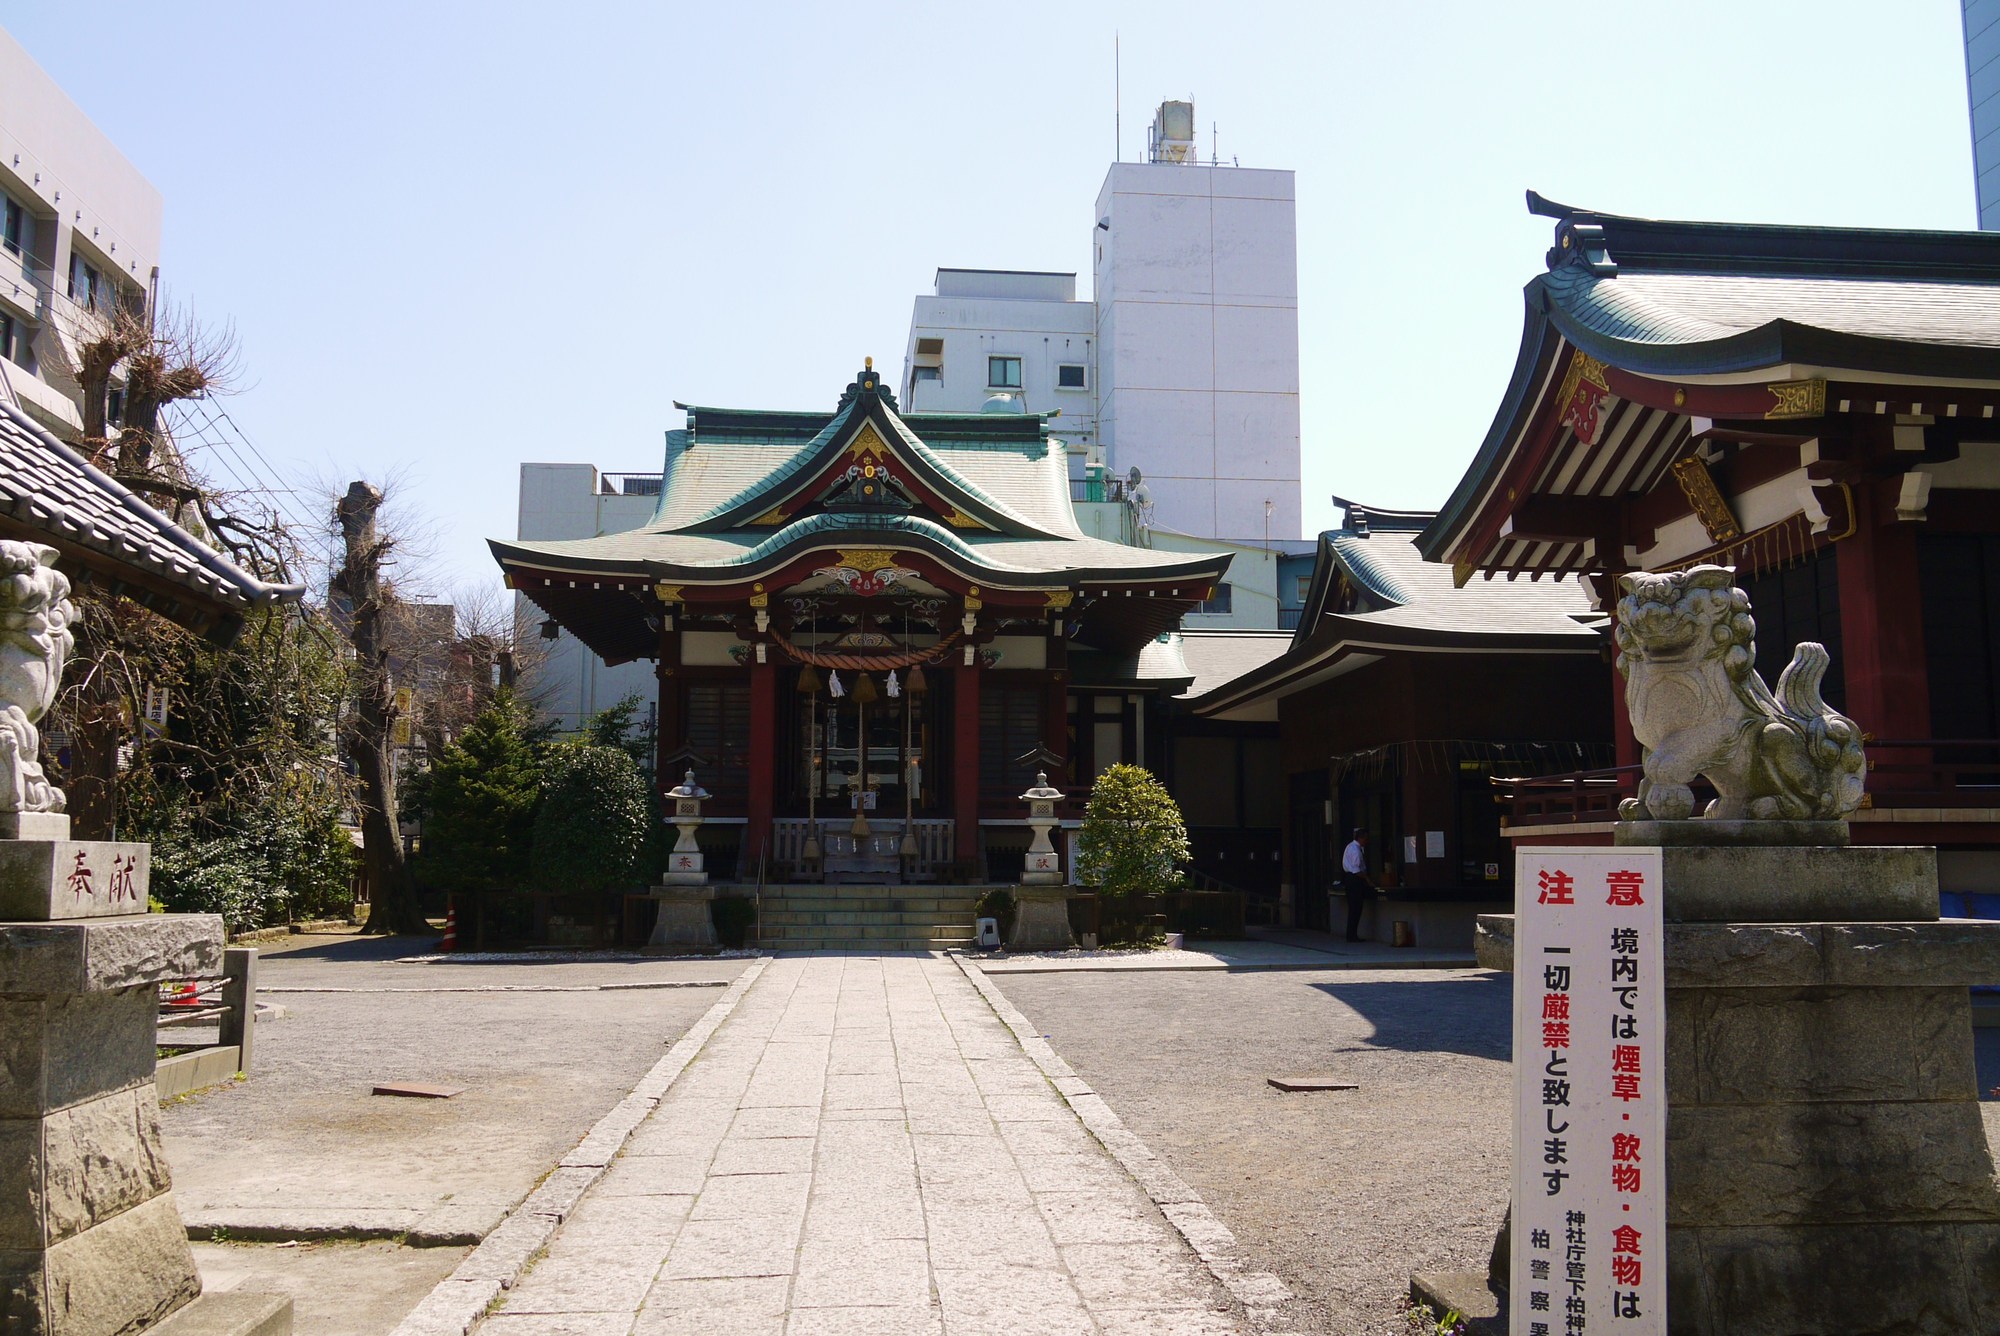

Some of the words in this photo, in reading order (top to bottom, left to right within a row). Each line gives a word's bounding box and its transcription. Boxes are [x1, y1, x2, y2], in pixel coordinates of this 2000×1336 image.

[1541, 946, 1571, 1197] 一切厳禁と致します
[1565, 1210, 1586, 1336] 神社庁管下柏神
